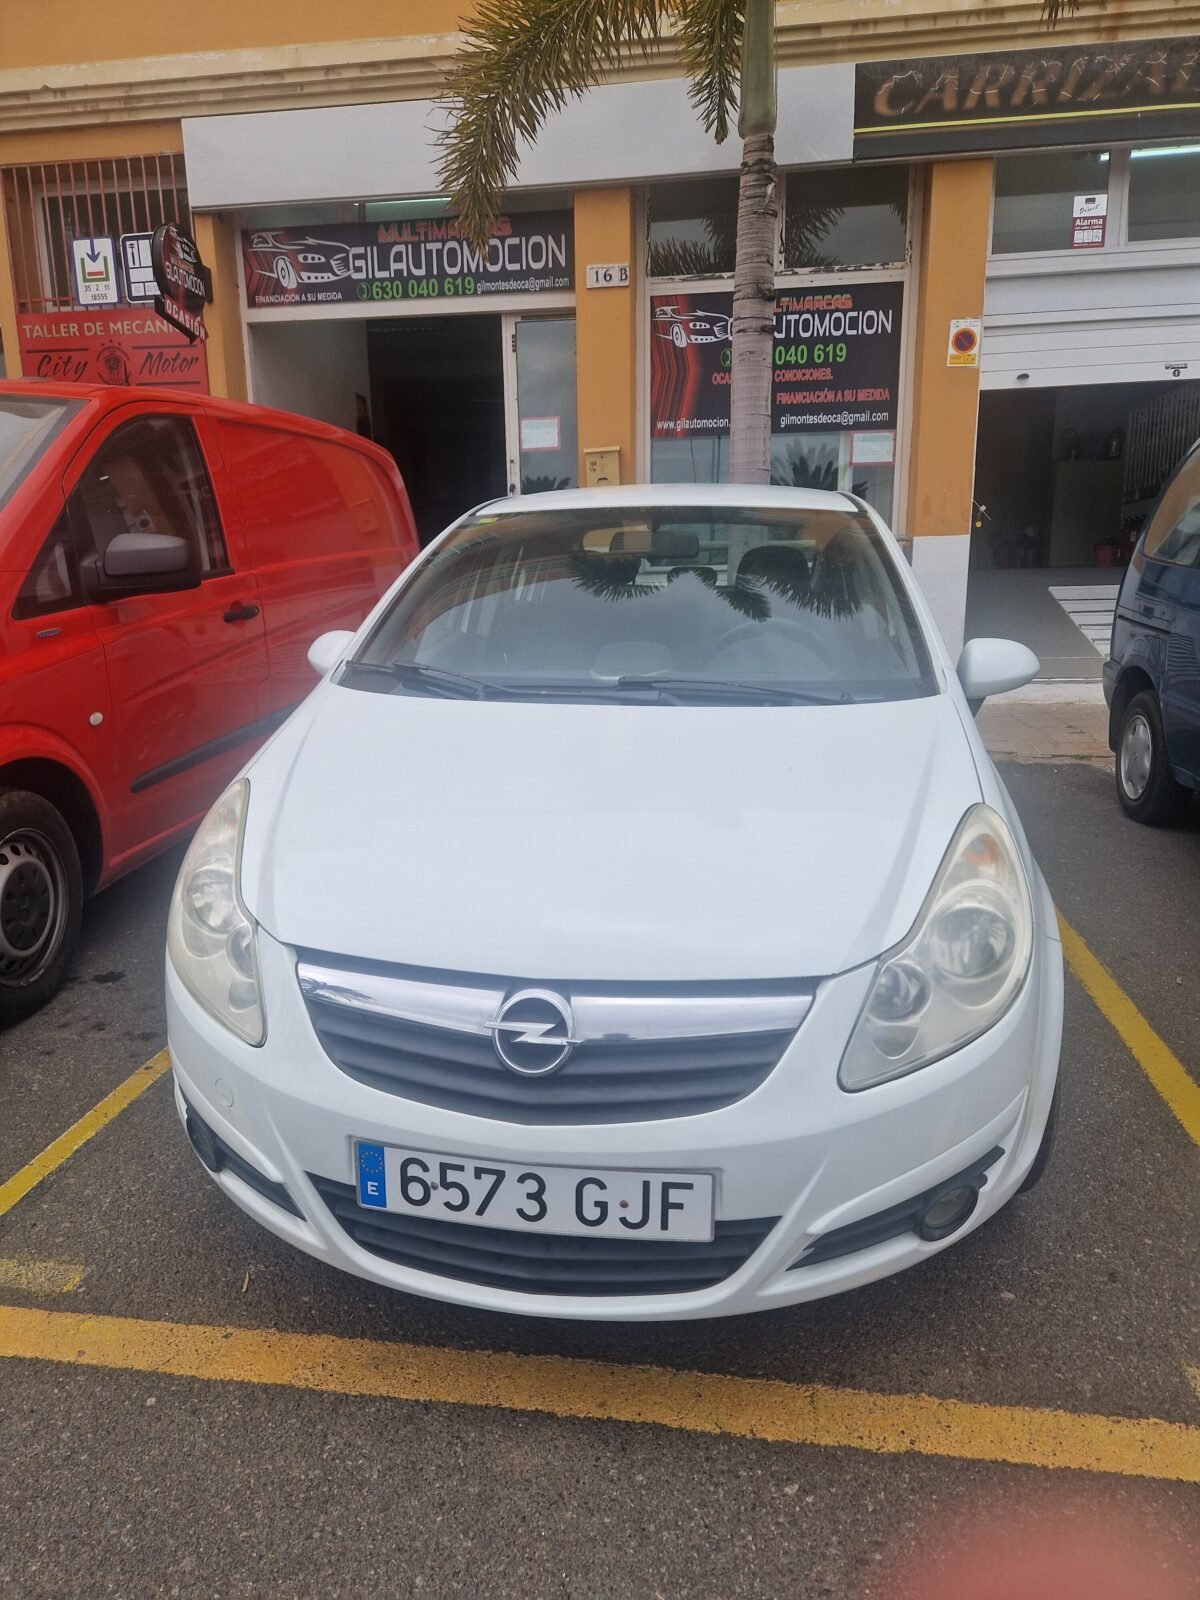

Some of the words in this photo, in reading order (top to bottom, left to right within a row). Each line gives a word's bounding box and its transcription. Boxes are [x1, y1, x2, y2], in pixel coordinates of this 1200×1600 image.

[377, 216, 513, 243] MULTIMAAS
[1075, 218, 1103, 226] Alarma
[349, 234, 566, 279] GILAUTOMOCION
[595, 269, 612, 283] 16
[620, 267, 628, 281] B
[301, 293, 306, 302] A
[307, 292, 317, 302] SU
[317, 291, 343, 301] MEDIDA
[372, 281, 402, 299] 630
[408, 279, 438, 297] 040
[444, 277, 474, 296] 619
[476, 277, 570, 295] gilmontesdeoca@gmail.com
[773, 294, 853, 312] LTIMARCAS
[22, 323, 79, 339] TALLER
[84, 321, 105, 336] DE
[109, 316, 180, 336] MECÁNI
[166, 300, 206, 340] OCASIÓN
[773, 310, 893, 339] UTOMOCION
[775, 345, 807, 365] 040
[813, 343, 847, 363] 619
[37, 352, 88, 382] City
[139, 351, 199, 376] Motor
[712, 372, 732, 385] OCA
[774, 368, 833, 382] CONDICIONES.
[776, 388, 835, 404] FINANCIACIÓN
[836, 391, 843, 402] A
[844, 389, 856, 402] SU
[857, 388, 890, 401] MEDIDA
[656, 416, 731, 431] www.gilautomocion.
[780, 410, 889, 427] gilmontesdeoca@gmail.com
[367, 1182, 379, 1196] E
[400, 1157, 548, 1223] 6573
[575, 1177, 694, 1231] GJF
